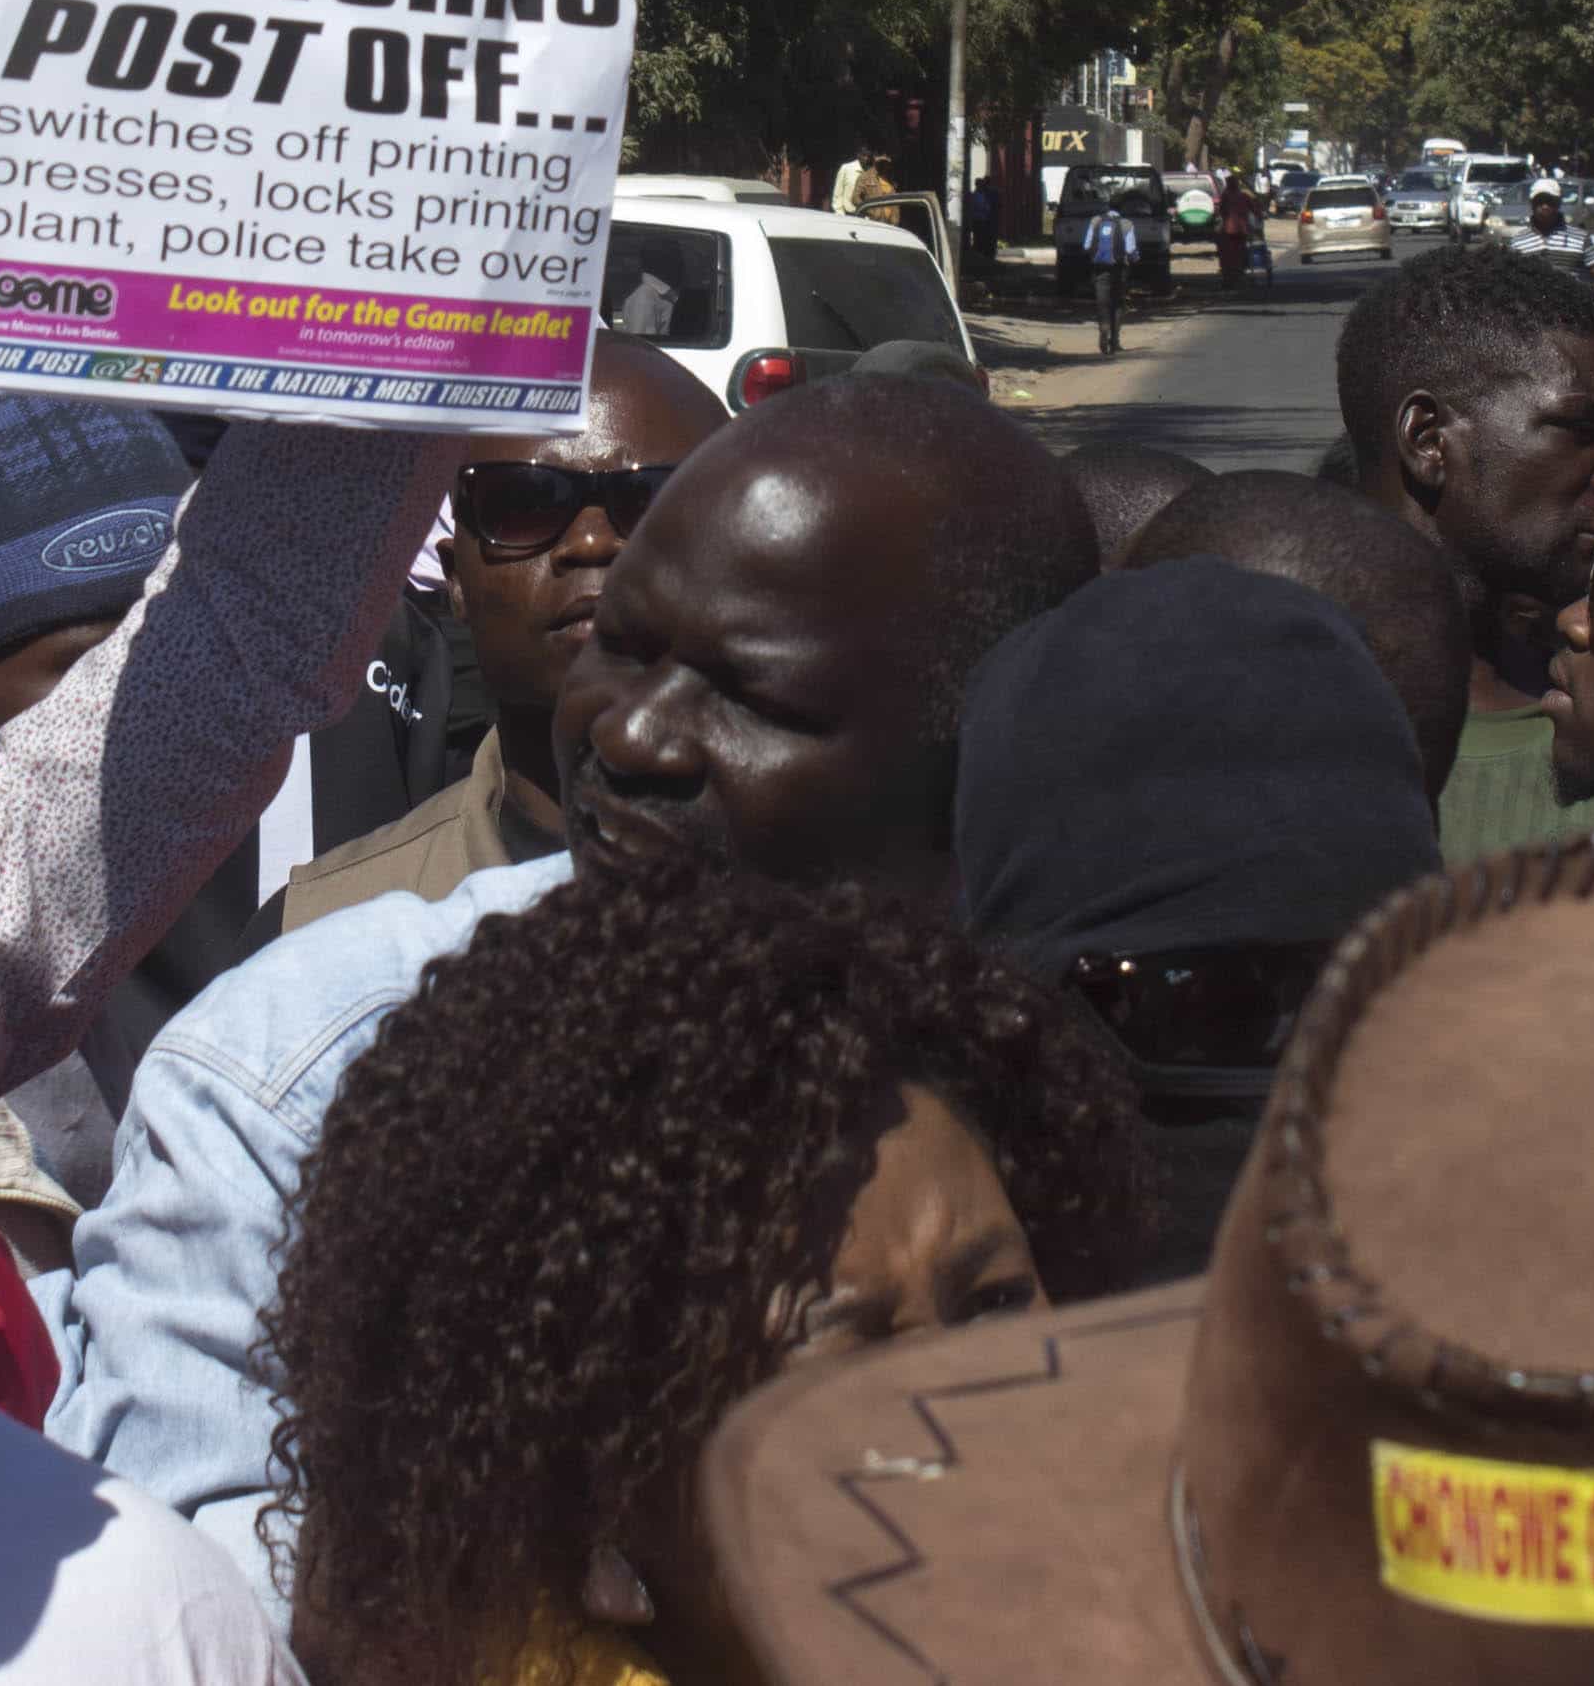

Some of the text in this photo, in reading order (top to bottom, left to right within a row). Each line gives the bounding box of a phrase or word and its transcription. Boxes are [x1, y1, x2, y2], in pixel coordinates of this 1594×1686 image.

[276, 125, 350, 163] off
[368, 134, 571, 193] printing
[255, 170, 394, 220] locks
[414, 189, 601, 246] printing
[160, 220, 326, 265] police
[348, 232, 461, 276] take
[480, 249, 587, 285] over
[168, 283, 573, 340] Look out for the Game leaflet
[299, 325, 455, 352] in tomorrow's edition
[28, 351, 91, 374] POST
[163, 361, 222, 386] STILL
[227, 367, 269, 390] THE
[270, 370, 369, 399] NATION'S
[373, 378, 435, 402] MOST
[438, 384, 519, 408] TRUSTED
[522, 388, 580, 411] MEDIA
[1389, 1464, 1575, 1582] CHONGWE
